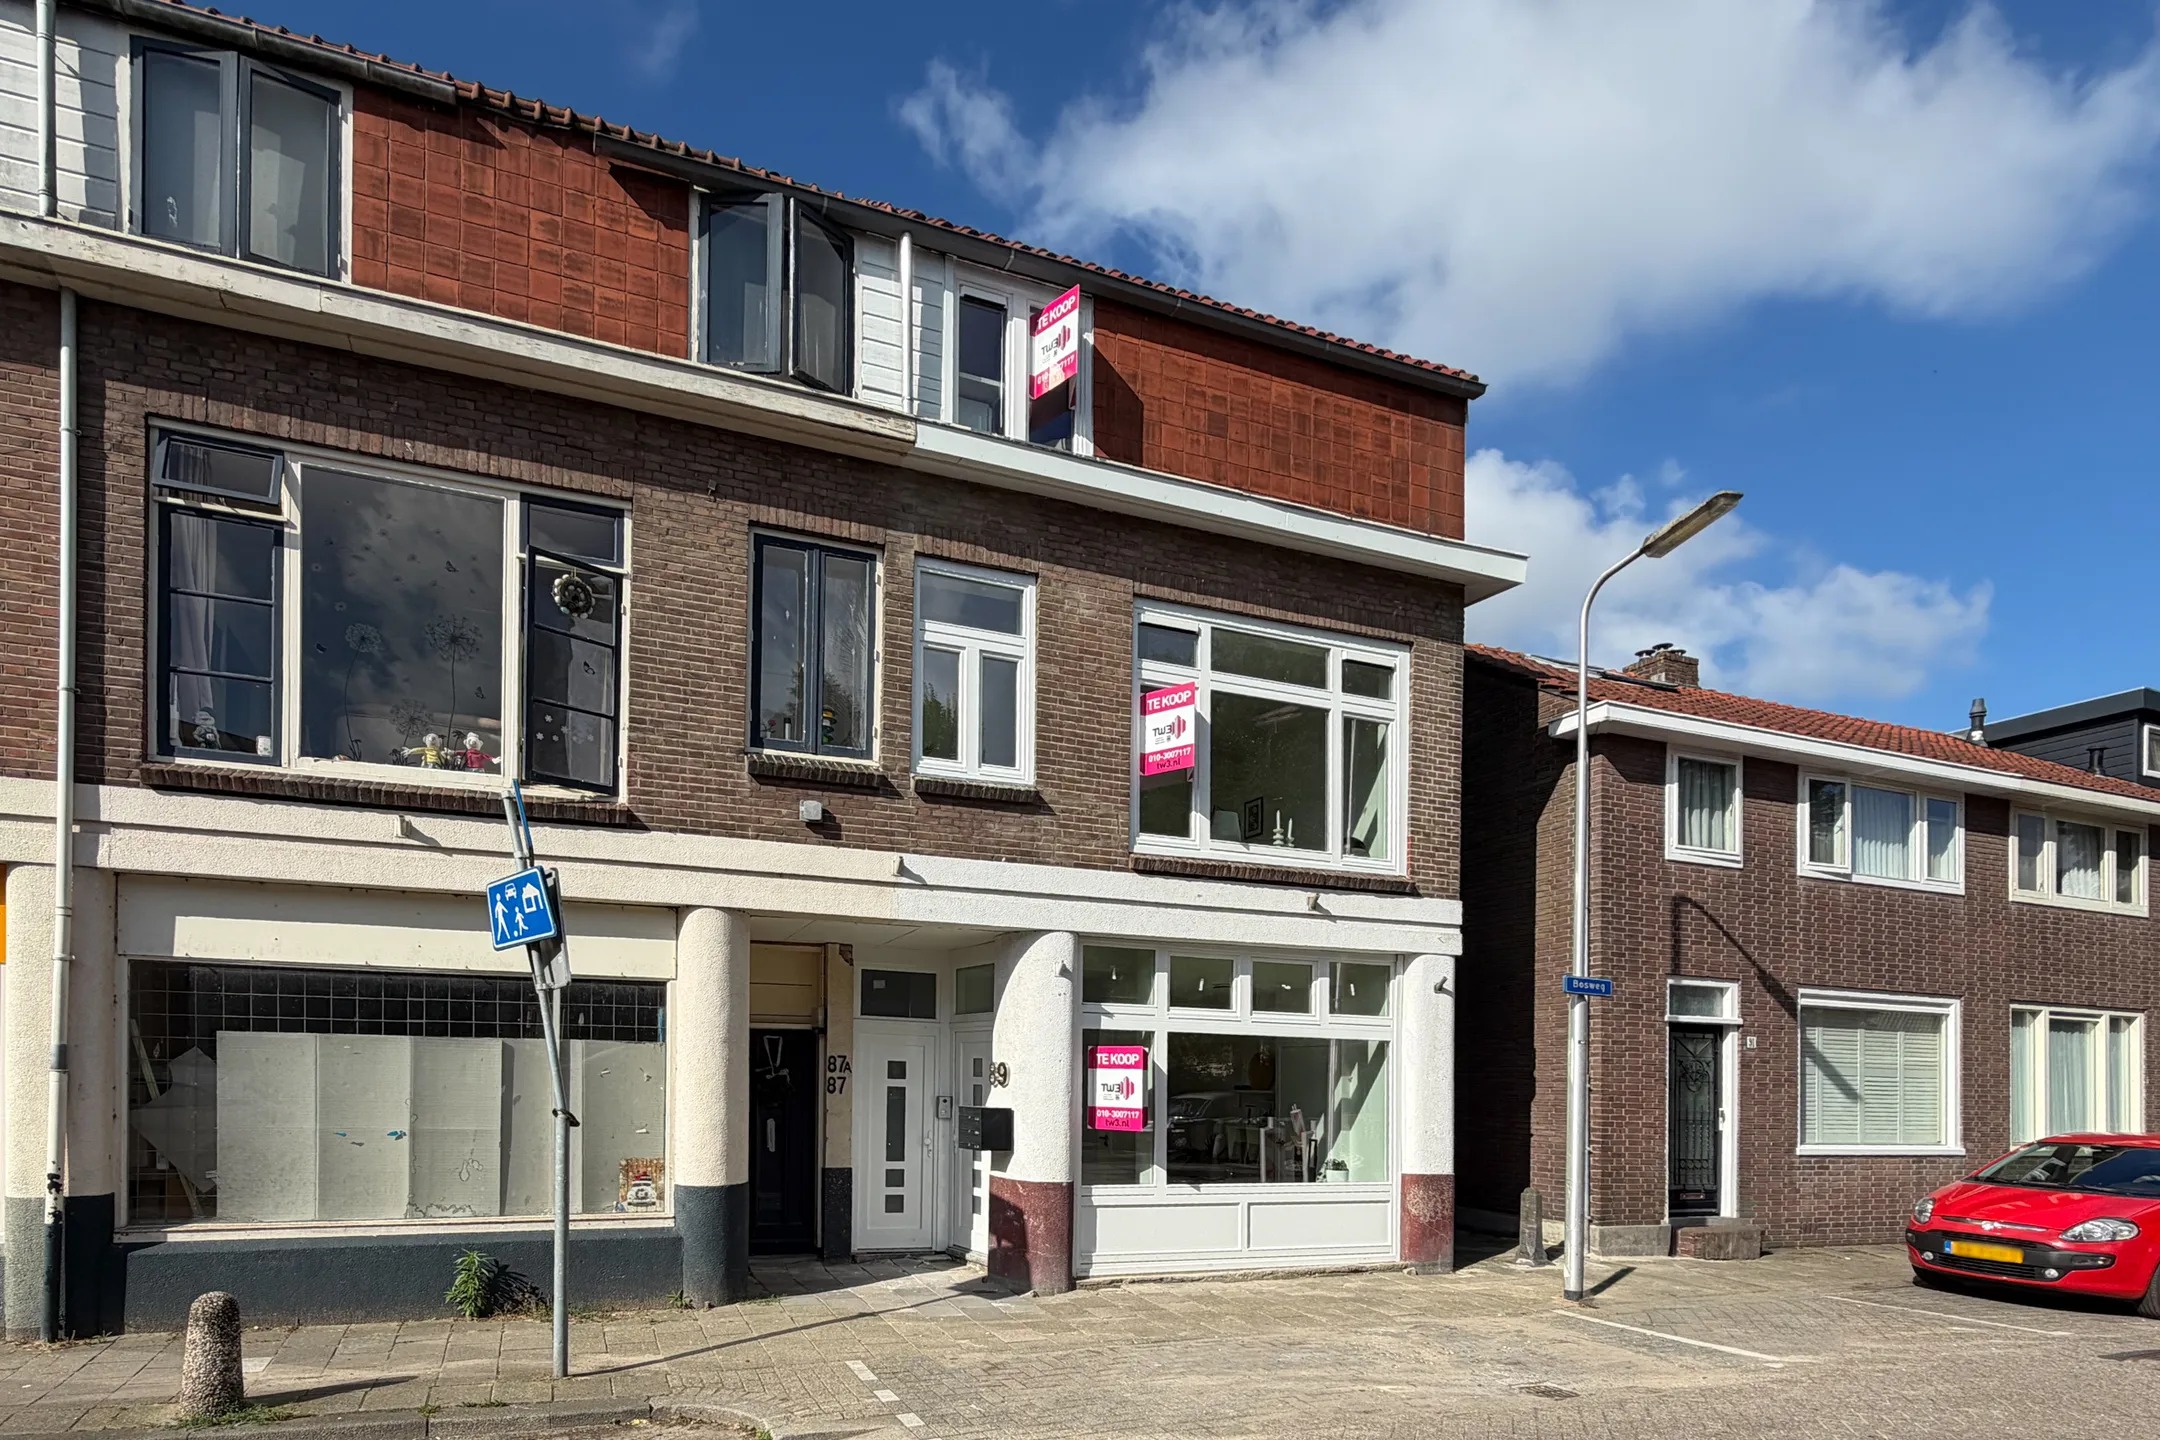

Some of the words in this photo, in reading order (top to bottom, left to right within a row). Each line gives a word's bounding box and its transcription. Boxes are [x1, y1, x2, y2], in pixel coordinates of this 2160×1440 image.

[1037, 313, 1050, 330] TE
[1049, 295, 1076, 322] KOOP
[1147, 698, 1160, 710] TE
[1161, 690, 1192, 707] KOOP
[1152, 724, 1172, 737] TW3
[1148, 747, 1191, 762] 010-3007117
[1156, 758, 1181, 769] tw3.nl
[1572, 979, 1606, 993] Bosweg
[828, 1055, 852, 1073] 87A
[1096, 1053, 1109, 1064] TE
[1110, 1053, 1140, 1065] KOOP
[989, 1061, 1008, 1087] 89
[827, 1077, 847, 1094] 87
[1101, 1083, 1121, 1093] TW3
[1096, 1110, 1140, 1119] 010-3007117
[1105, 1119, 1130, 1128] tw3.nl
